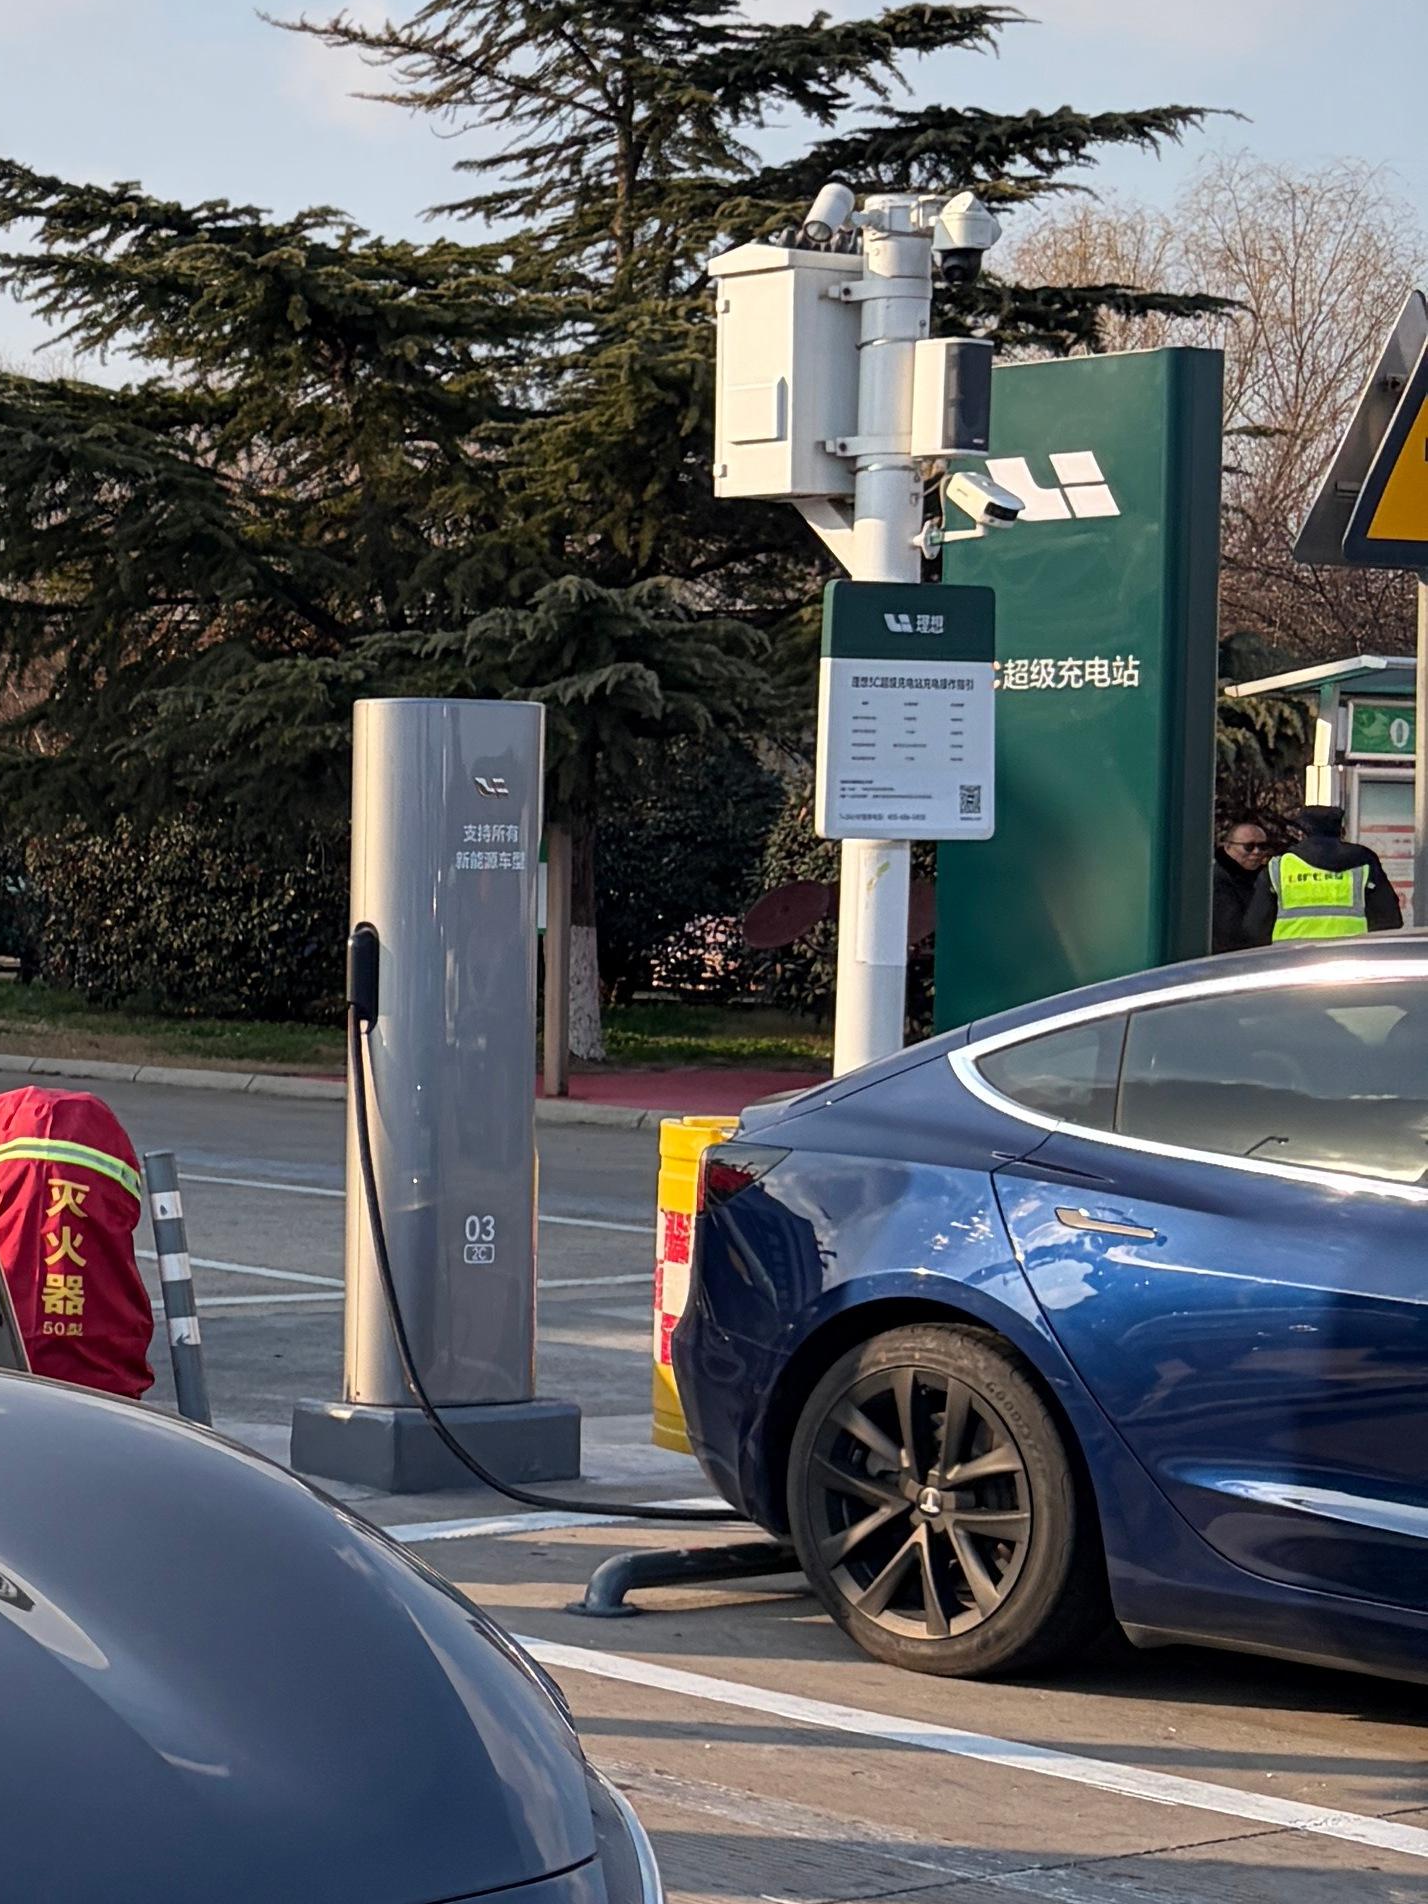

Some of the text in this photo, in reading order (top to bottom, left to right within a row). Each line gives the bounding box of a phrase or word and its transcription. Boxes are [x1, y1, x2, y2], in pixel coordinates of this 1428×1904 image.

[993, 654, 1141, 691] 超级充电站
[463, 824, 520, 844] 支持所有
[455, 850, 526, 870] 新能源车型
[464, 1215, 497, 1243] 03
[42, 1178, 91, 1316] 灭火器
[471, 1247, 488, 1262] 2C
